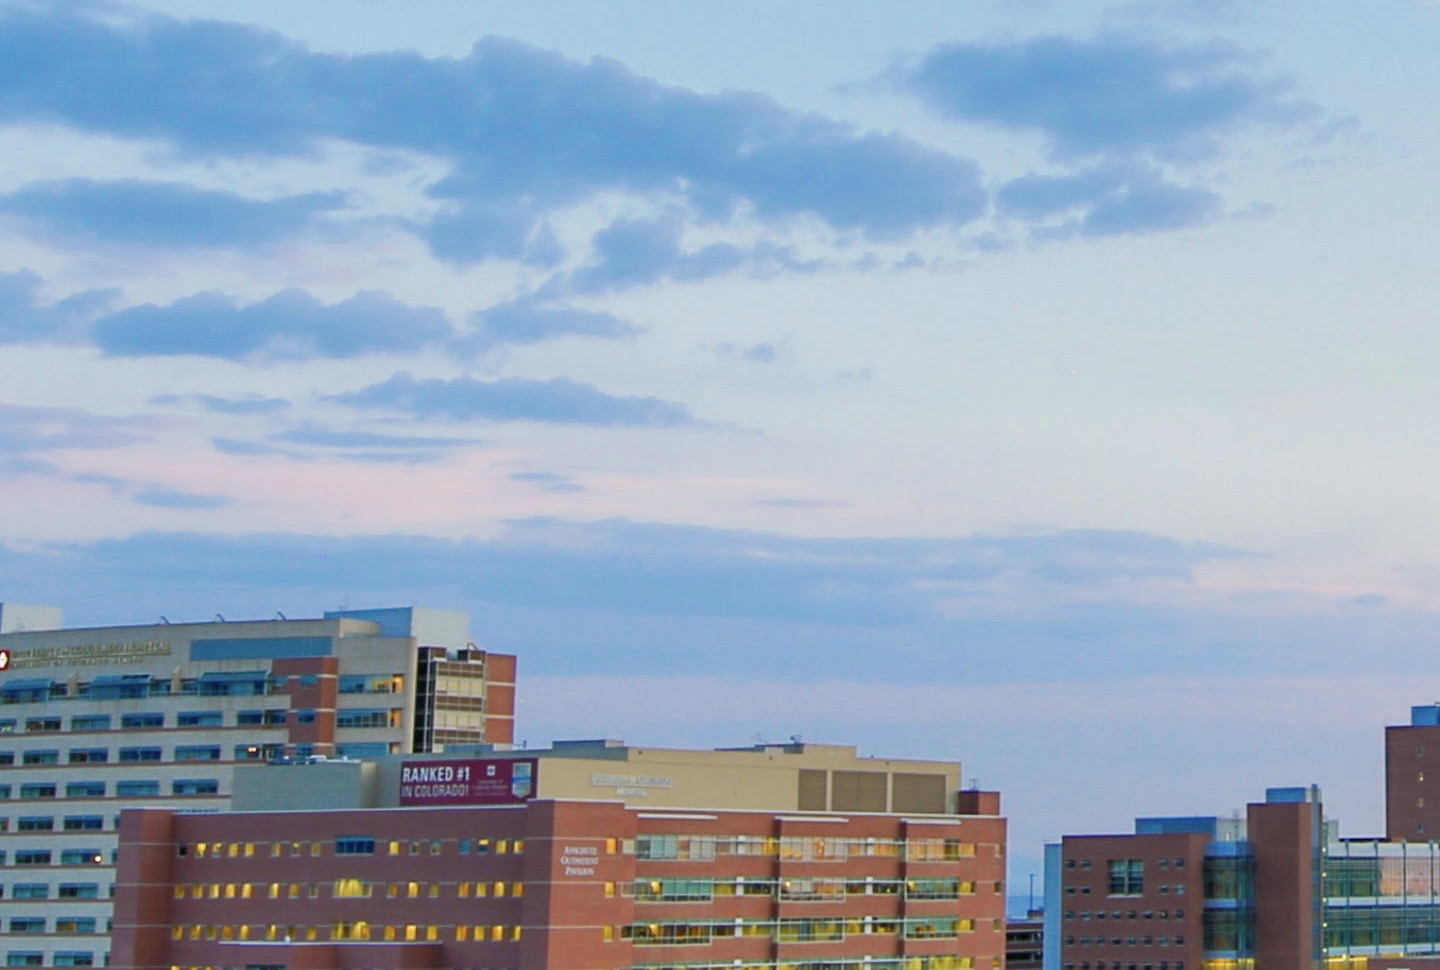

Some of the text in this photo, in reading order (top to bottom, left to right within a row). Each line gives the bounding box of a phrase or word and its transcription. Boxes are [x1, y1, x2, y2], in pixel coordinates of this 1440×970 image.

[402, 766, 470, 783] RANKED #1
[401, 785, 412, 798] IN
